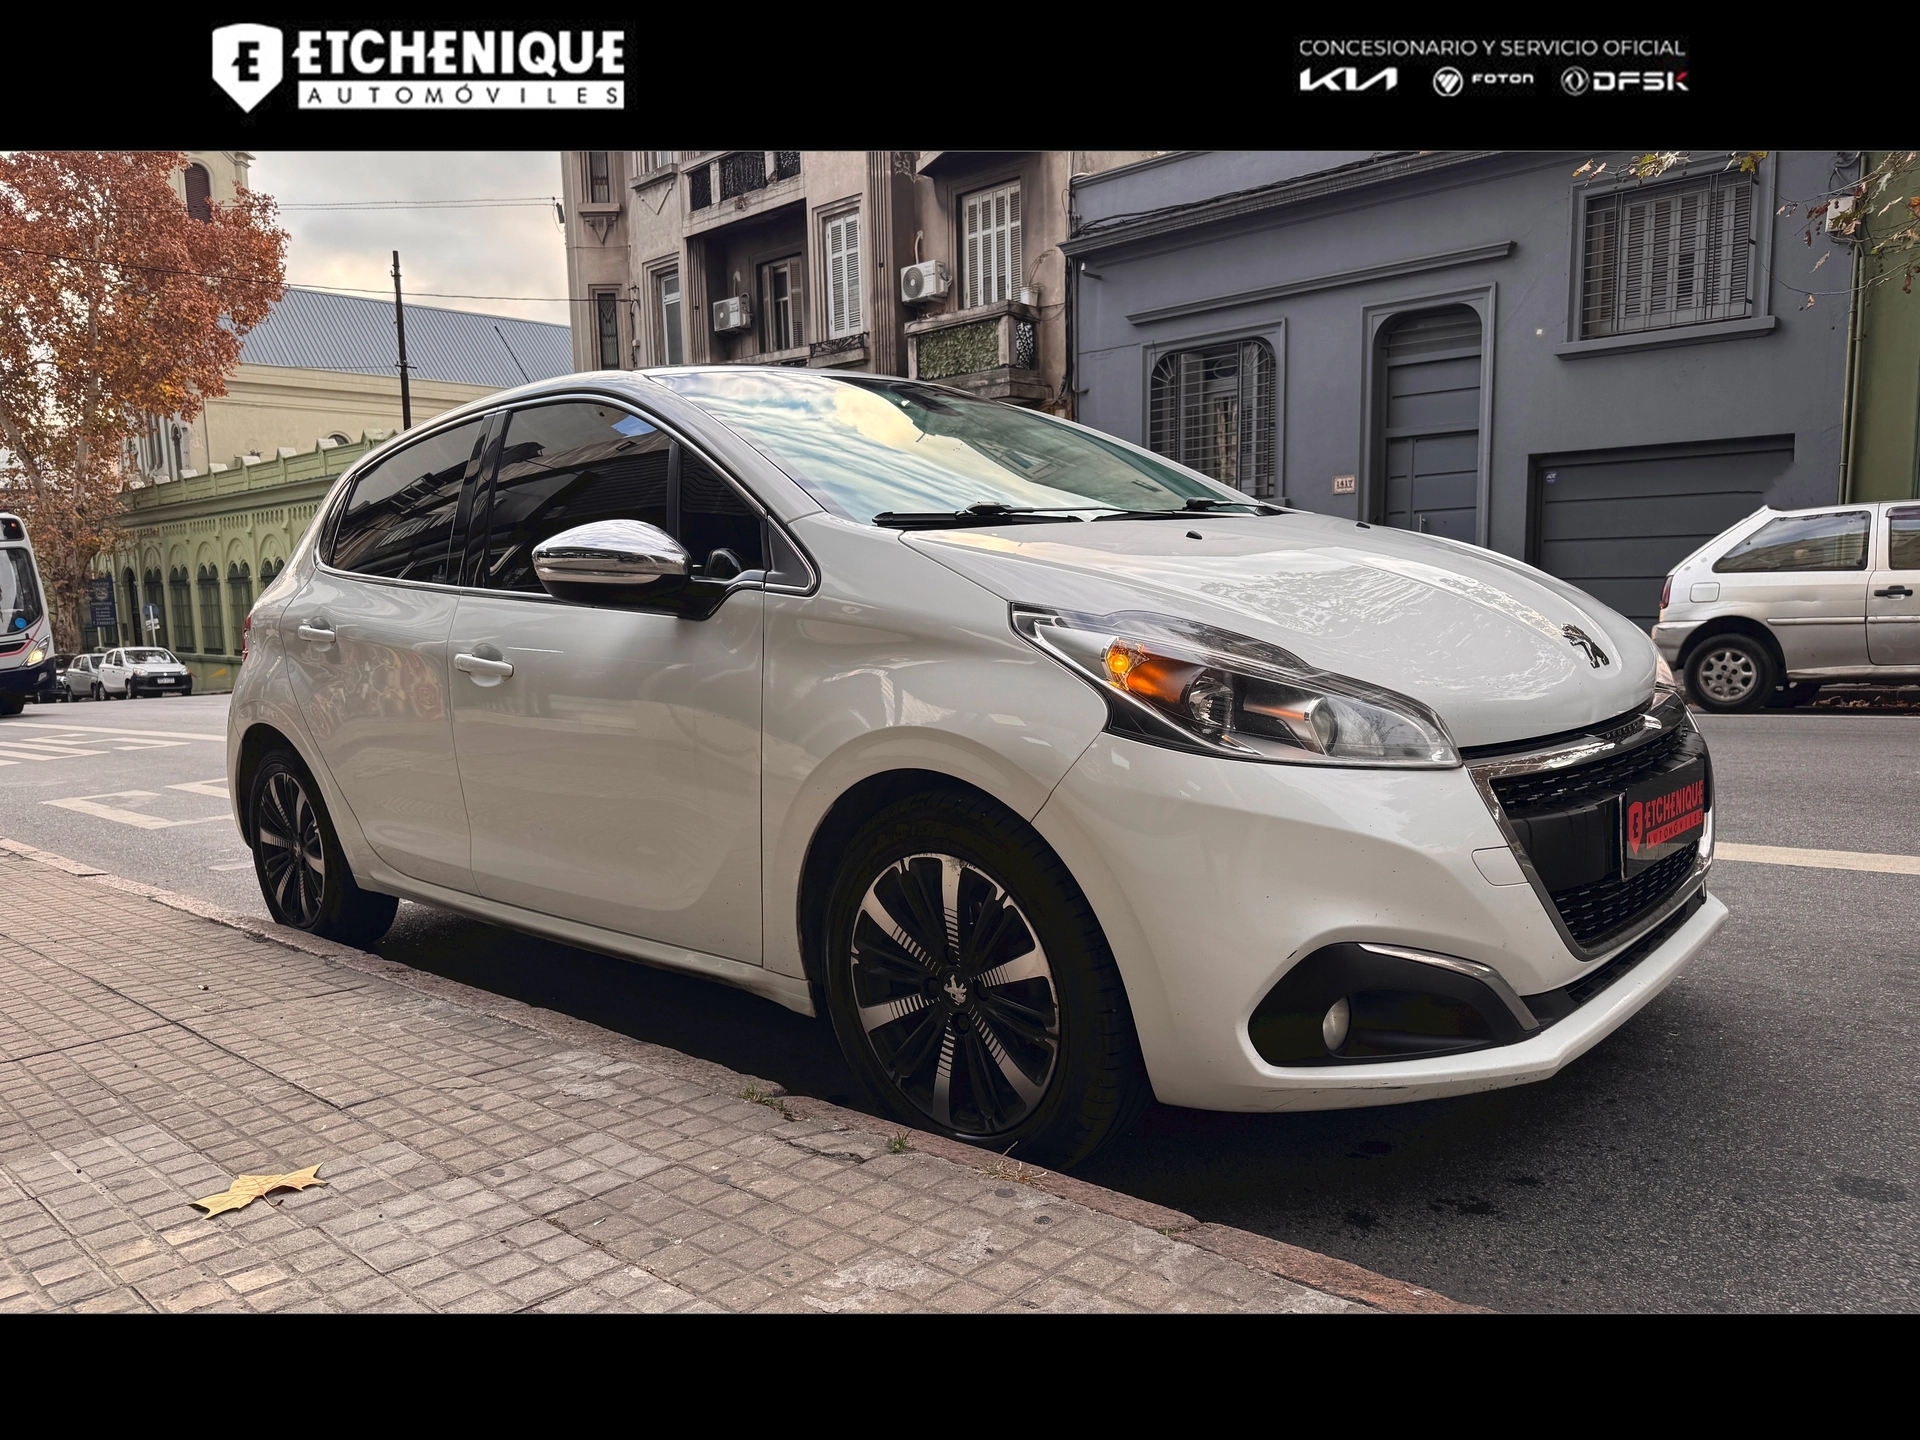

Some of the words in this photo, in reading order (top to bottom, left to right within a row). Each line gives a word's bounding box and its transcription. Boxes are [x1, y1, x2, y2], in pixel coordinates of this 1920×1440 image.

[1336, 479, 1353, 489] 1417
[1645, 780, 1704, 829] ETCHENIQUE
[1648, 810, 1703, 845] AUTOMÓVILES
